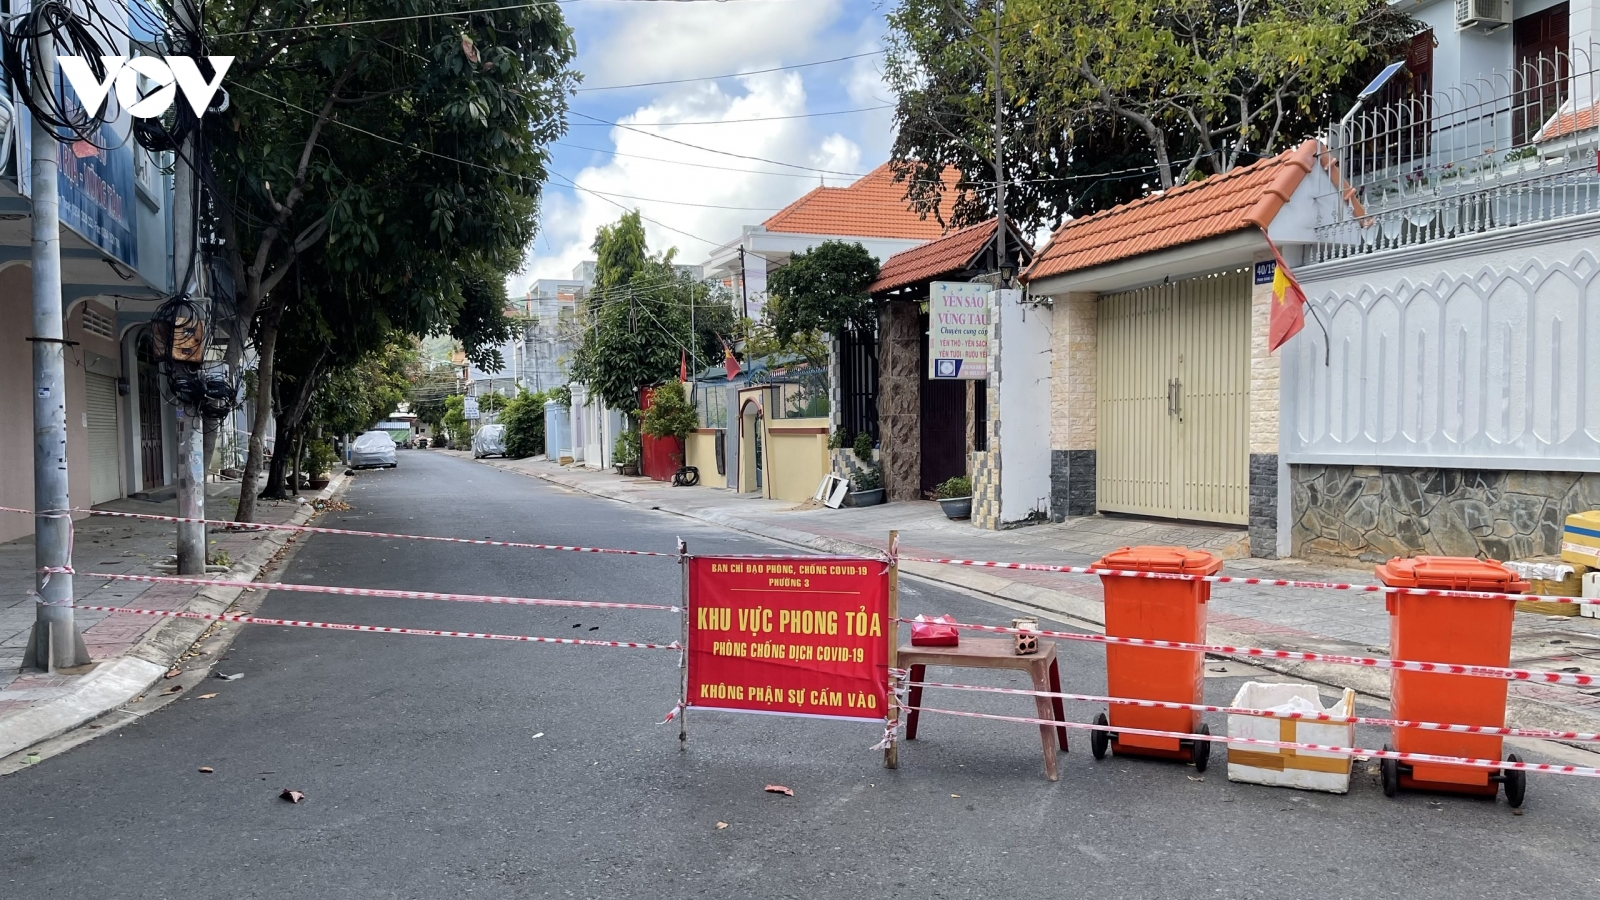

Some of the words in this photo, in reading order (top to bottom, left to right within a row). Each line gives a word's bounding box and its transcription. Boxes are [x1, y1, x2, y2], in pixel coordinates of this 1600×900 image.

[942, 291, 962, 307] YẾN
[965, 293, 984, 308] SÀO
[938, 310, 965, 325] VŨNG
[967, 311, 988, 326] TÀU
[940, 326, 962, 336] Chuyên
[963, 328, 977, 337] cung
[940, 338, 950, 347] YẾN
[965, 338, 975, 347] YẾN
[939, 348, 949, 358] YẾN
[711, 563, 728, 574] BAN
[730, 561, 744, 574] CHỈ
[746, 564, 763, 576] ĐẠO
[766, 562, 796, 576] PHÒNG,
[799, 562, 827, 576] CHỐNG
[829, 565, 868, 576] COVID-19
[768, 576, 802, 588] PHƯỜNG
[804, 578, 810, 588] 3
[697, 607, 731, 631] KHU
[738, 605, 773, 637] VỰC
[779, 609, 838, 635] PHONG
[845, 605, 882, 637] TỎA
[712, 641, 747, 657] PHÒNG
[750, 639, 785, 660] CHỐNG
[789, 645, 812, 663] DỊCH
[816, 646, 864, 663] COVID-19
[700, 683, 744, 701] KHÔNG
[748, 685, 783, 706] PHẬN
[788, 687, 806, 707] SỰ
[810, 686, 842, 707] CẤM
[847, 691, 877, 709] VÀO
